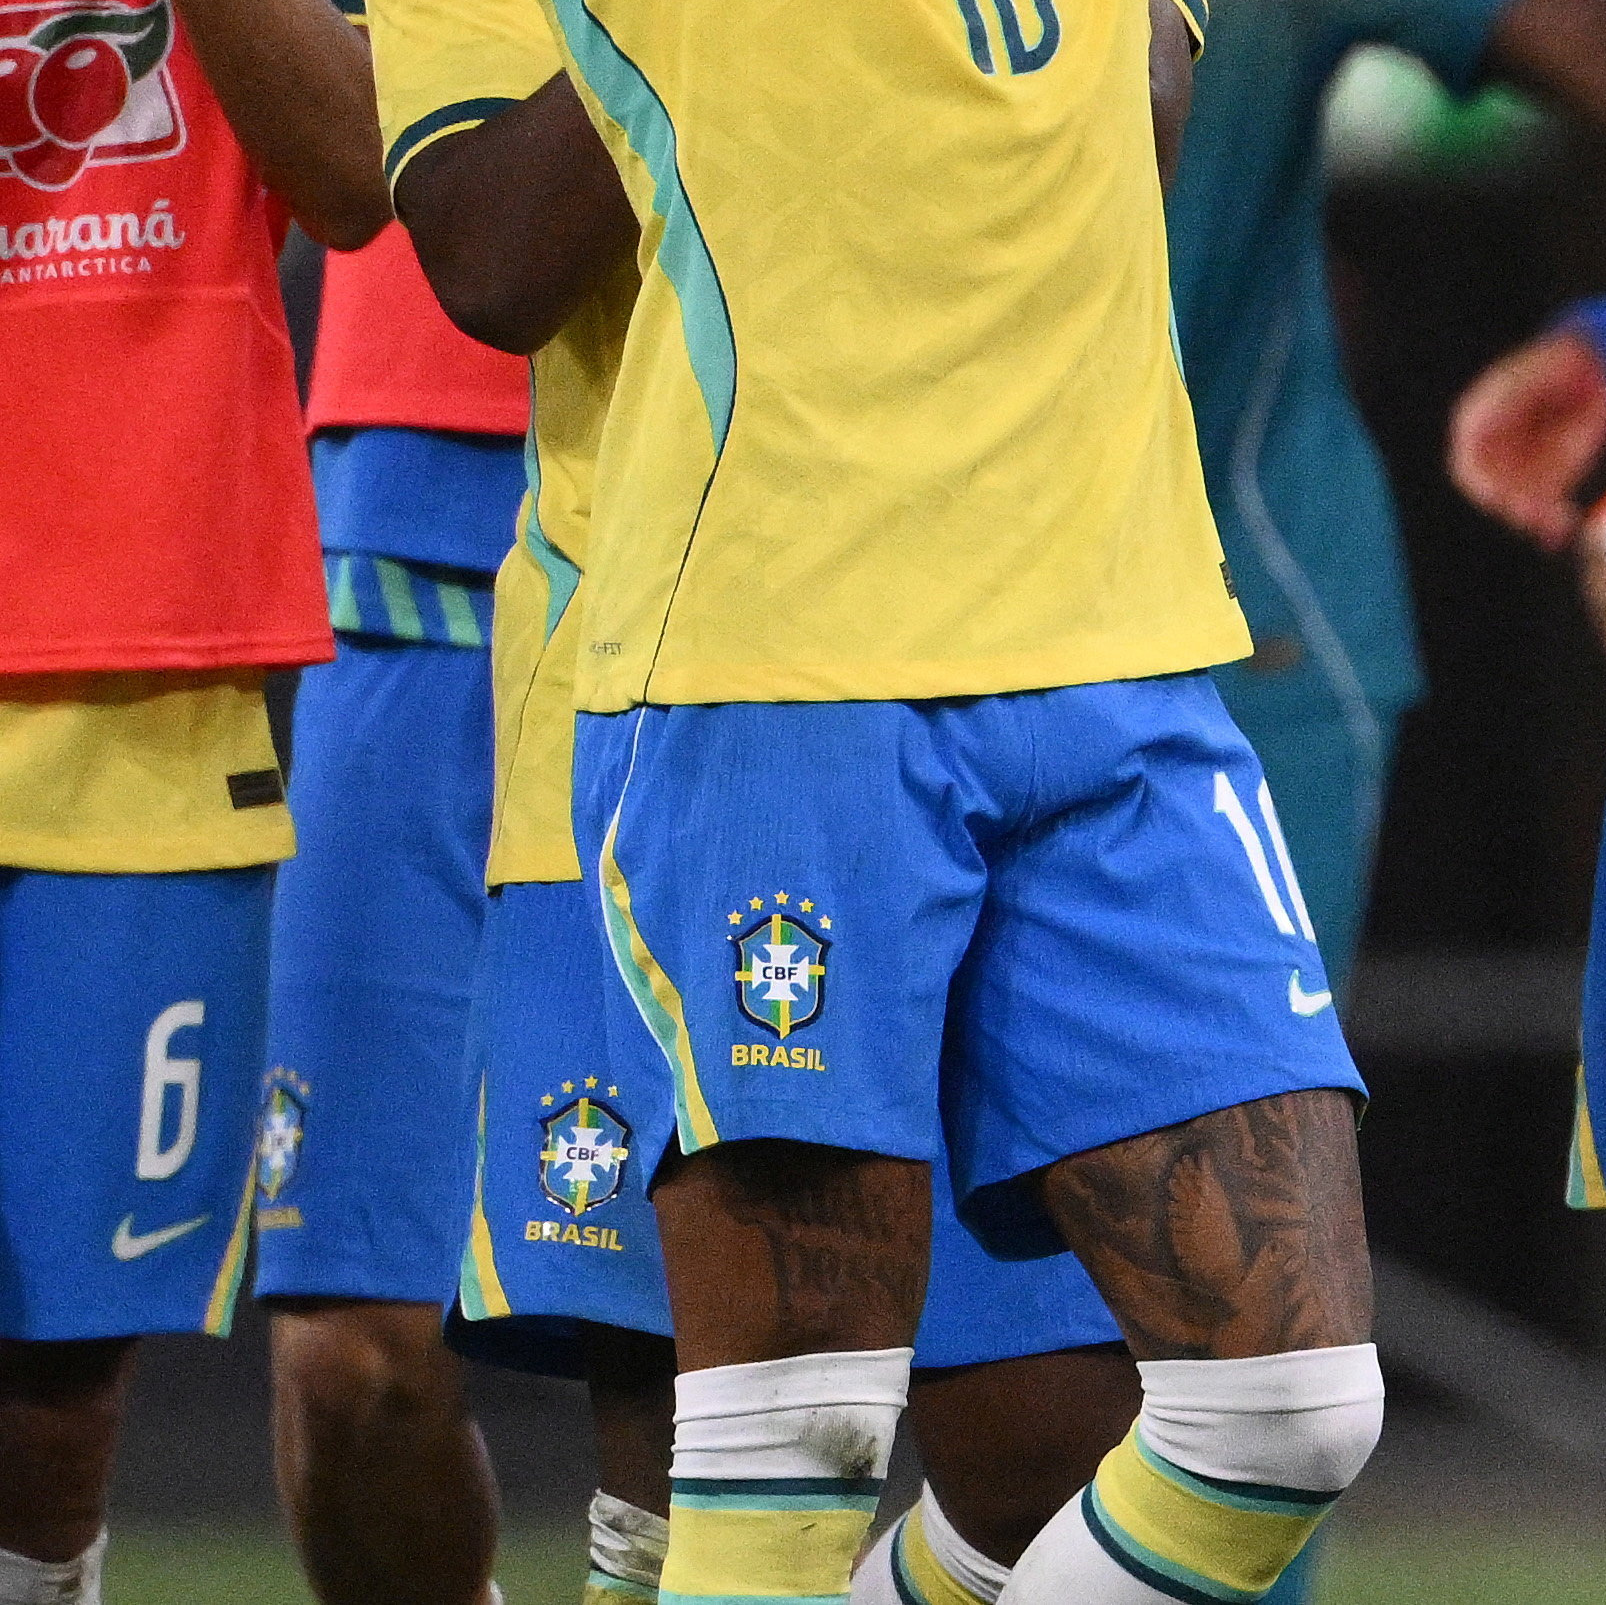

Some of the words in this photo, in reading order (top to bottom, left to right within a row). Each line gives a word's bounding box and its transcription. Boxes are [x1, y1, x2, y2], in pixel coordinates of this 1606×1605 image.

[0, 255, 153, 284] ANTARCTICA
[762, 965, 799, 981] CBF
[731, 1043, 826, 1072] BRASIL
[135, 1000, 206, 1181] 6
[566, 1146, 600, 1162] CBF
[524, 1220, 625, 1252] BRASIL
